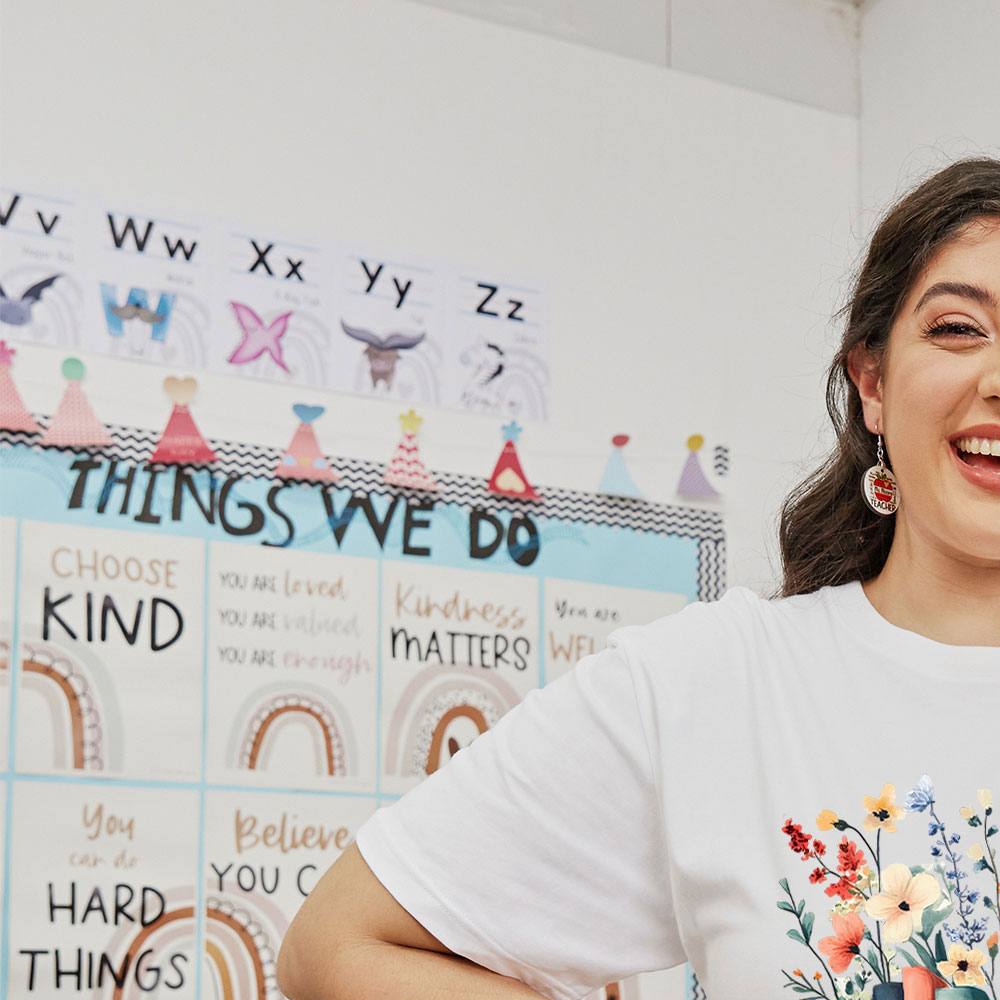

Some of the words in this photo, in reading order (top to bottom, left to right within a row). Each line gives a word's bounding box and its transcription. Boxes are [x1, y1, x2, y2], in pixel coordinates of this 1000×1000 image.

[67, 459, 295, 548] THINGS
[321, 488, 434, 557] WE
[468, 507, 541, 567] DO
[51, 547, 179, 590] CHOOSE
[219, 572, 248, 591] YOU
[252, 574, 276, 594] ARE
[283, 568, 349, 601] loved
[42, 586, 184, 652] KIND
[218, 608, 248, 628] YOU
[252, 612, 276, 631] ARE
[395, 582, 527, 631] Kindness
[217, 645, 247, 665] YOU
[251, 649, 276, 669] ARE
[282, 650, 373, 686] enough
[83, 803, 136, 841] You
[234, 809, 350, 854] Believe
[211, 863, 279, 894] YOU
[49, 882, 165, 927] HARD
[19, 947, 189, 992] THINGS
